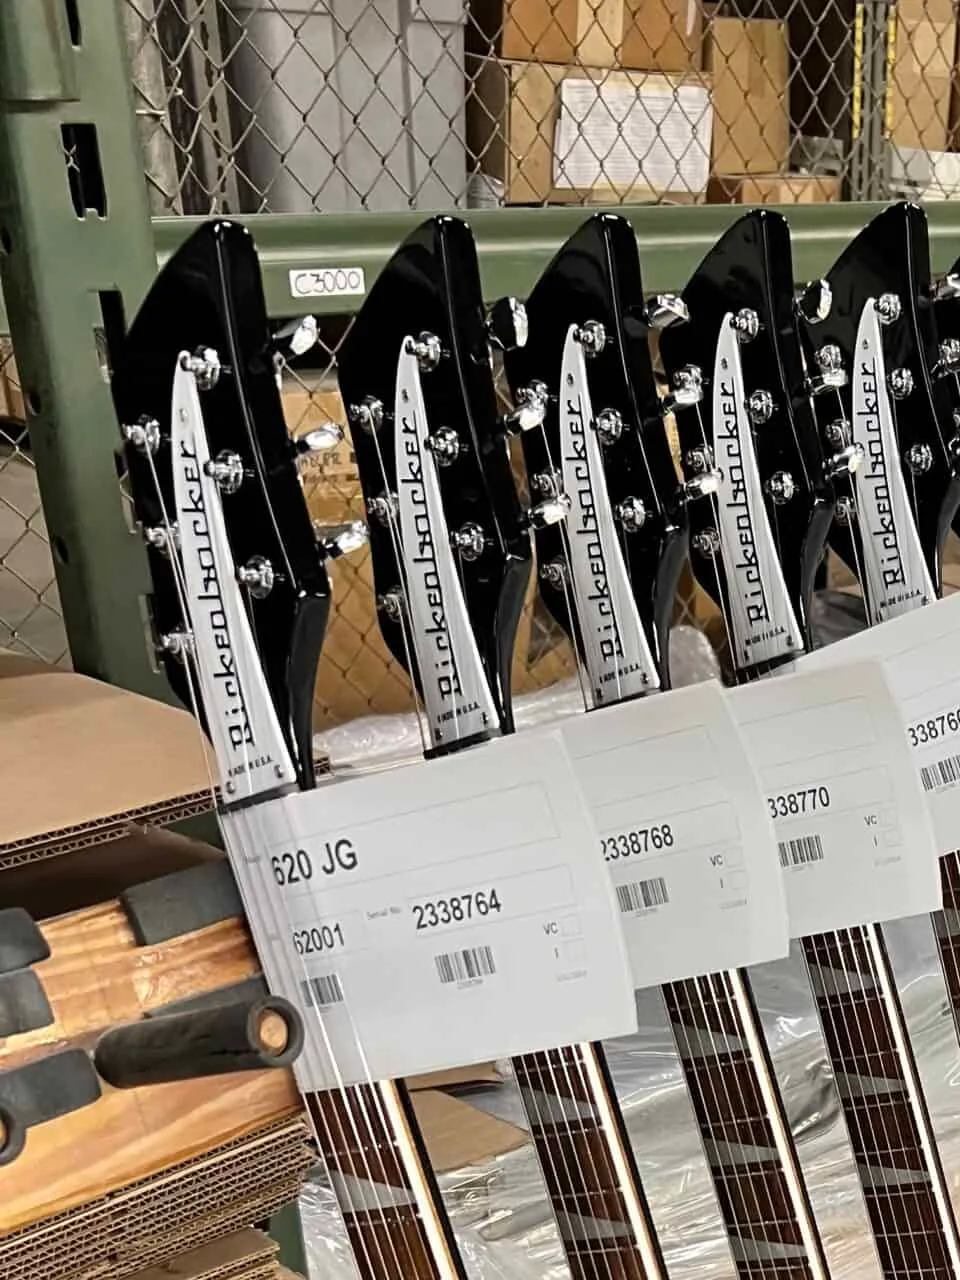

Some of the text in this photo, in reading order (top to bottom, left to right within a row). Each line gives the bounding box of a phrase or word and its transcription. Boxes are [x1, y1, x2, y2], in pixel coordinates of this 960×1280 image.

[295, 270, 361, 294] C3000
[857, 357, 906, 590] Rickenbacker
[717, 376, 770, 628] Rickenbacker
[566, 391, 624, 661] Rickenbacker
[401, 409, 464, 701] Rickenbacker
[181, 431, 256, 751] Rickenbacker
[767, 786, 830, 818] 338770
[864, 815, 877, 826] VC
[271, 839, 359, 886] 620 JG
[710, 854, 723, 867] VC
[412, 888, 502, 930] 2338764
[543, 922, 558, 935] VC
[292, 923, 345, 955] 62001
